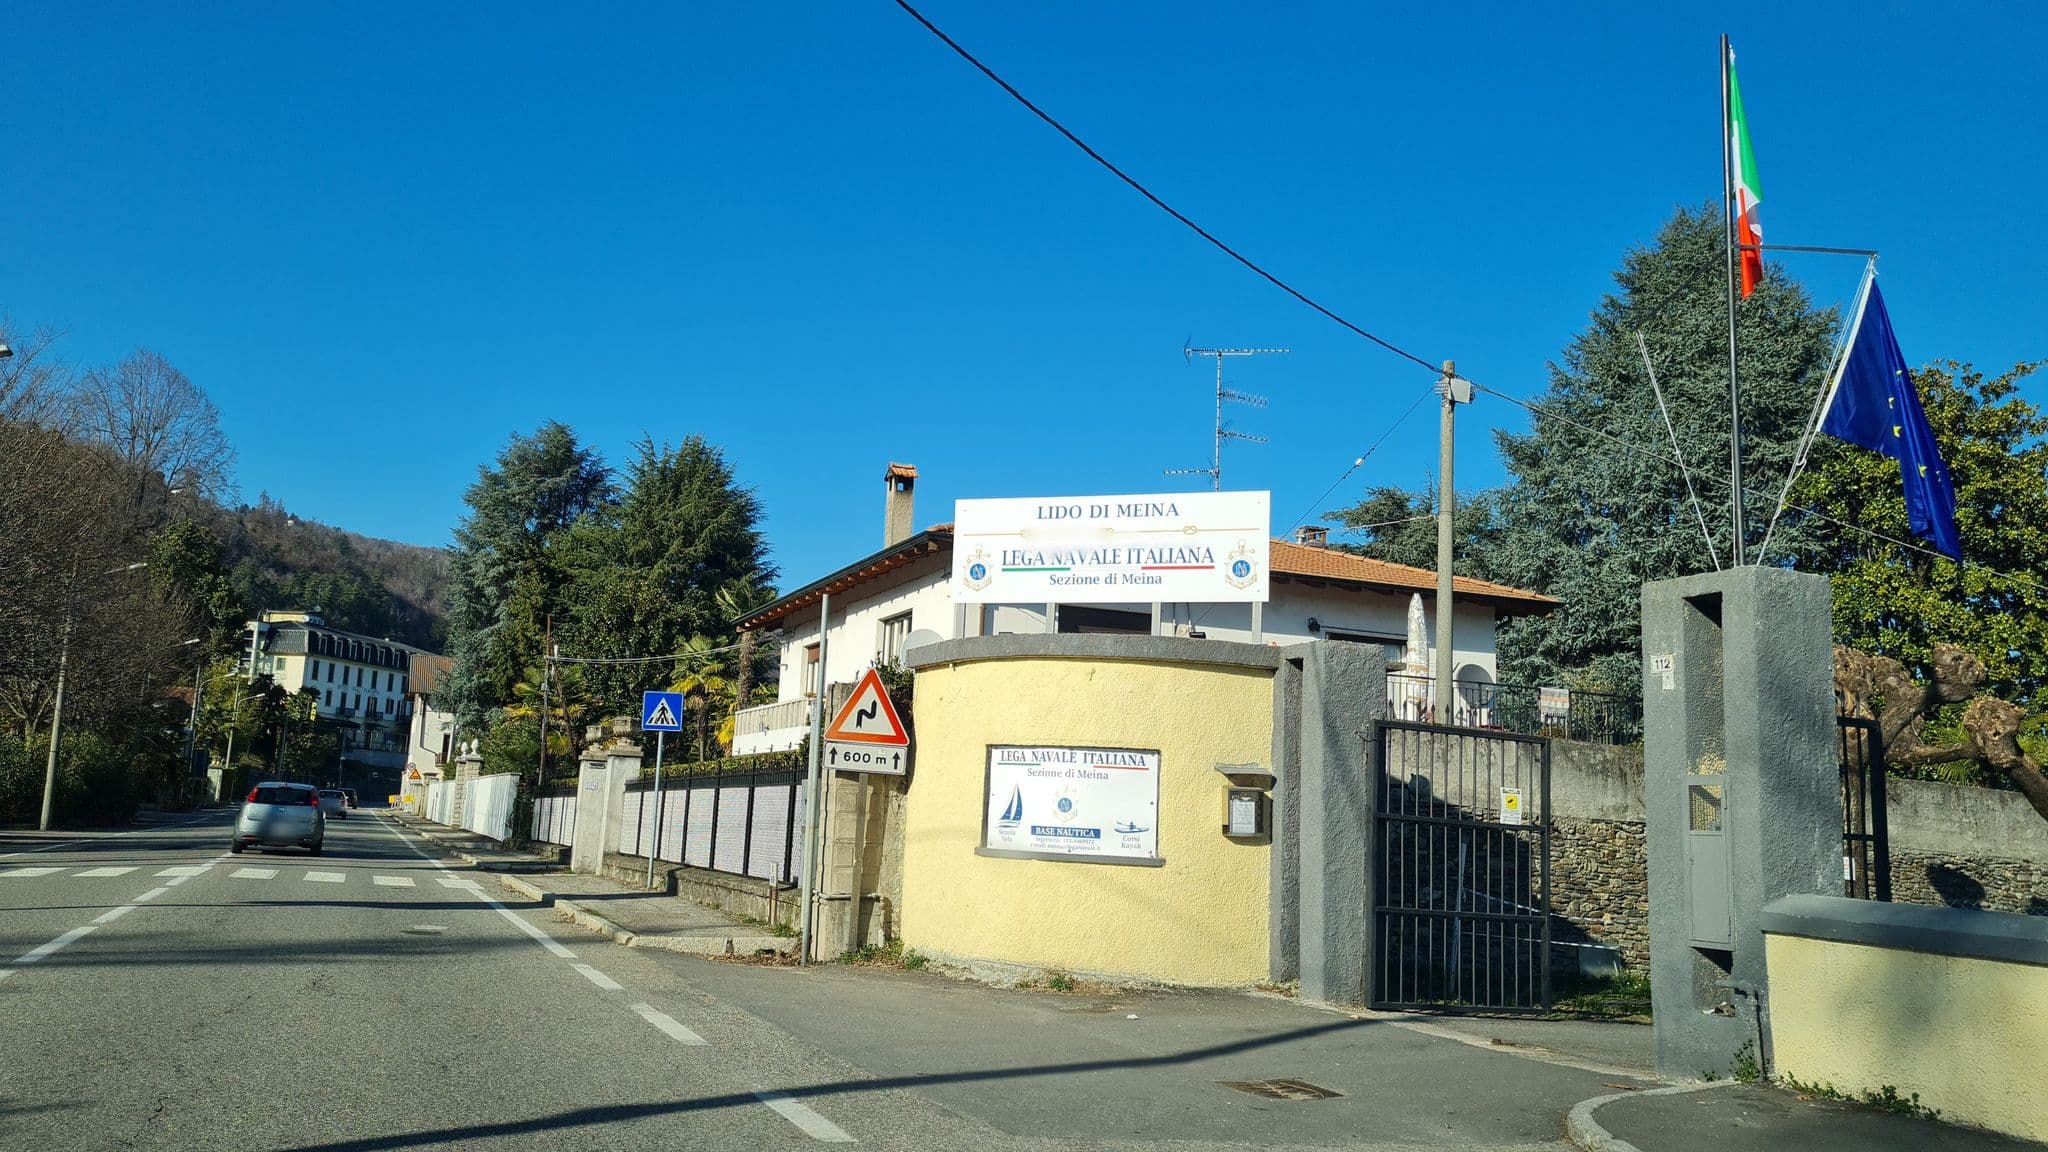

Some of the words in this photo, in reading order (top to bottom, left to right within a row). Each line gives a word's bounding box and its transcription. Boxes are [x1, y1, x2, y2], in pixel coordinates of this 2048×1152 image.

[1037, 505, 1083, 520] LIDO
[1089, 504, 1110, 519] DI
[1116, 502, 1180, 518] MEINA
[1002, 549, 1045, 566] LEGA
[1051, 548, 1122, 566] NAVALE
[1126, 546, 1215, 565] ITALIANA
[1049, 573, 1100, 586] Sezione
[1104, 573, 1117, 585] di
[1121, 572, 1162, 585] Meina
[1655, 658, 1671, 670] 112
[843, 751, 871, 764] 600
[875, 756, 887, 765] m
[1000, 750, 1027, 763] LEGA
[1031, 751, 1077, 764] NAVALE
[1083, 752, 1146, 767] ITALIANA
[1027, 767, 1062, 779] Sezione
[1065, 768, 1075, 779] di
[1076, 769, 1109, 780] Meina
[1035, 826, 1054, 837] BASE
[1055, 826, 1095, 838] NAUTICA
